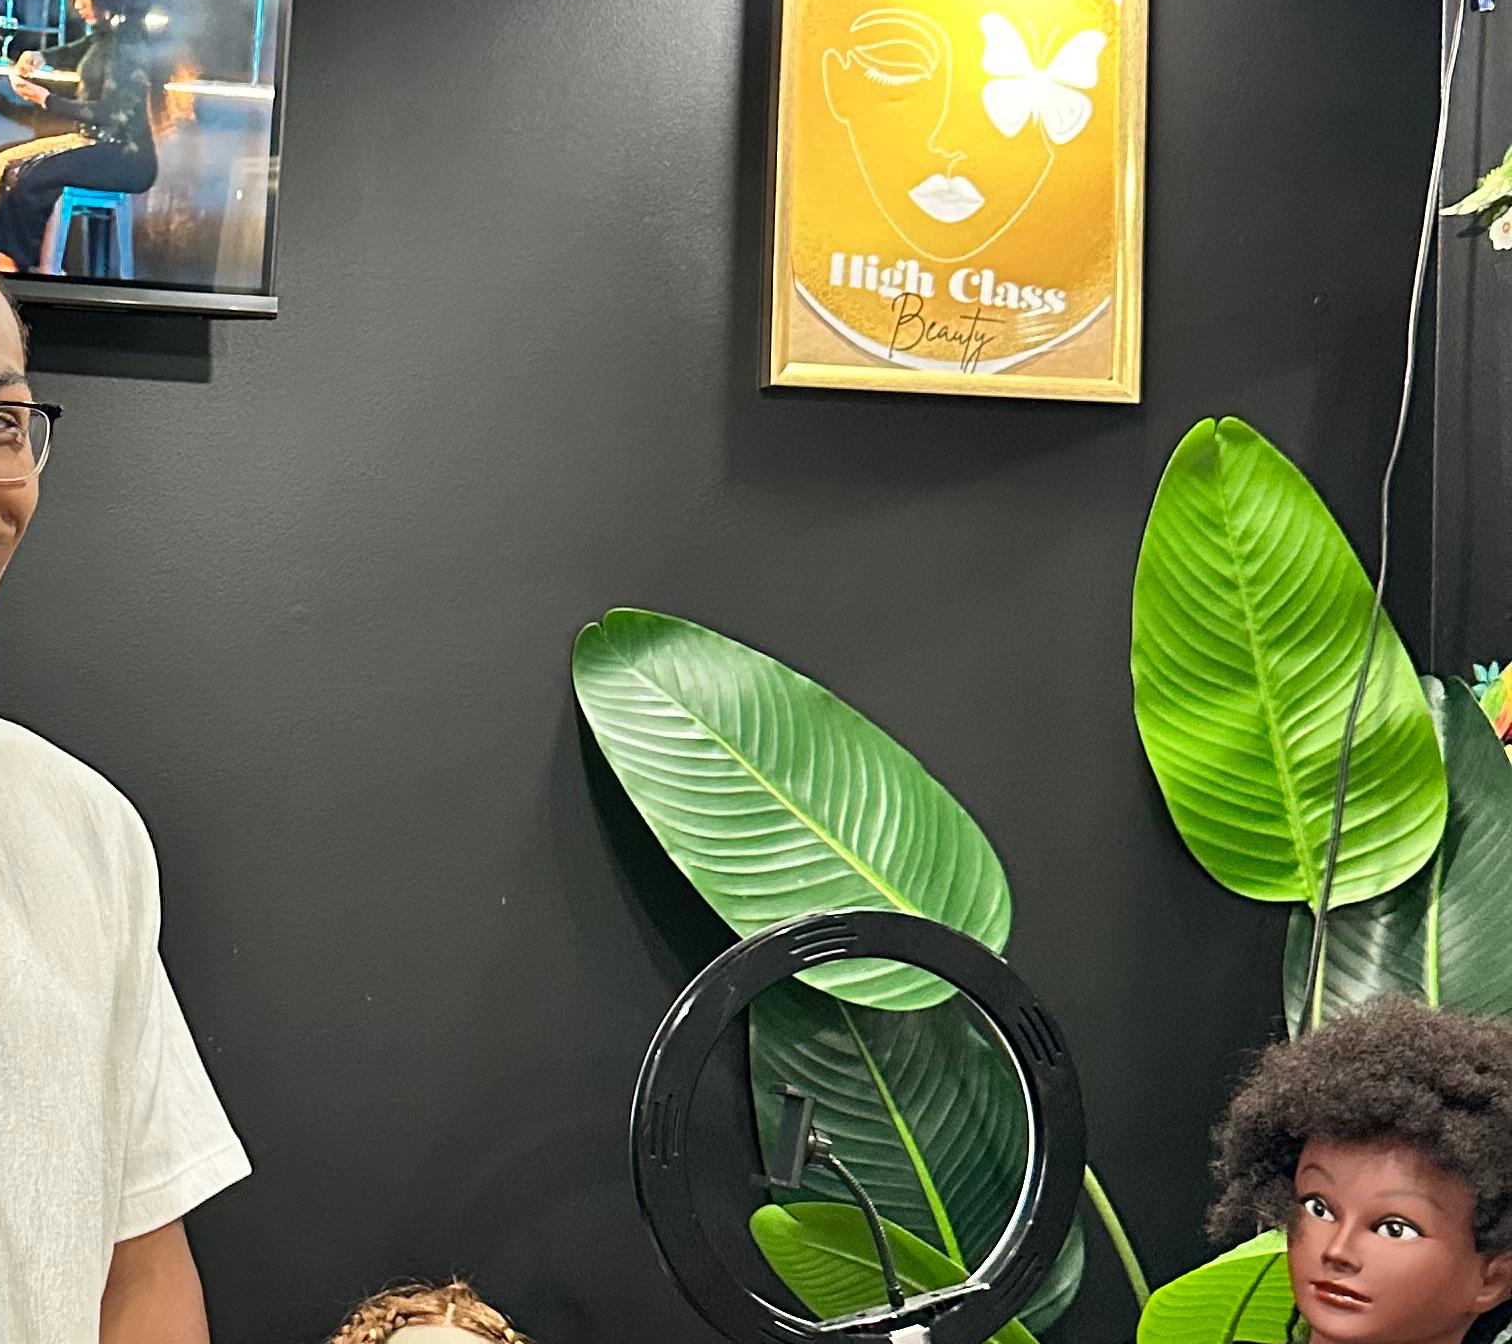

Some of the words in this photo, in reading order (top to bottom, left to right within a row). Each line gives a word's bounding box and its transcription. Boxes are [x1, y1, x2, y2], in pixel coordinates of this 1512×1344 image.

[829, 252, 935, 299] High
[949, 267, 1068, 315] Class
[888, 291, 1006, 374] Beauty
